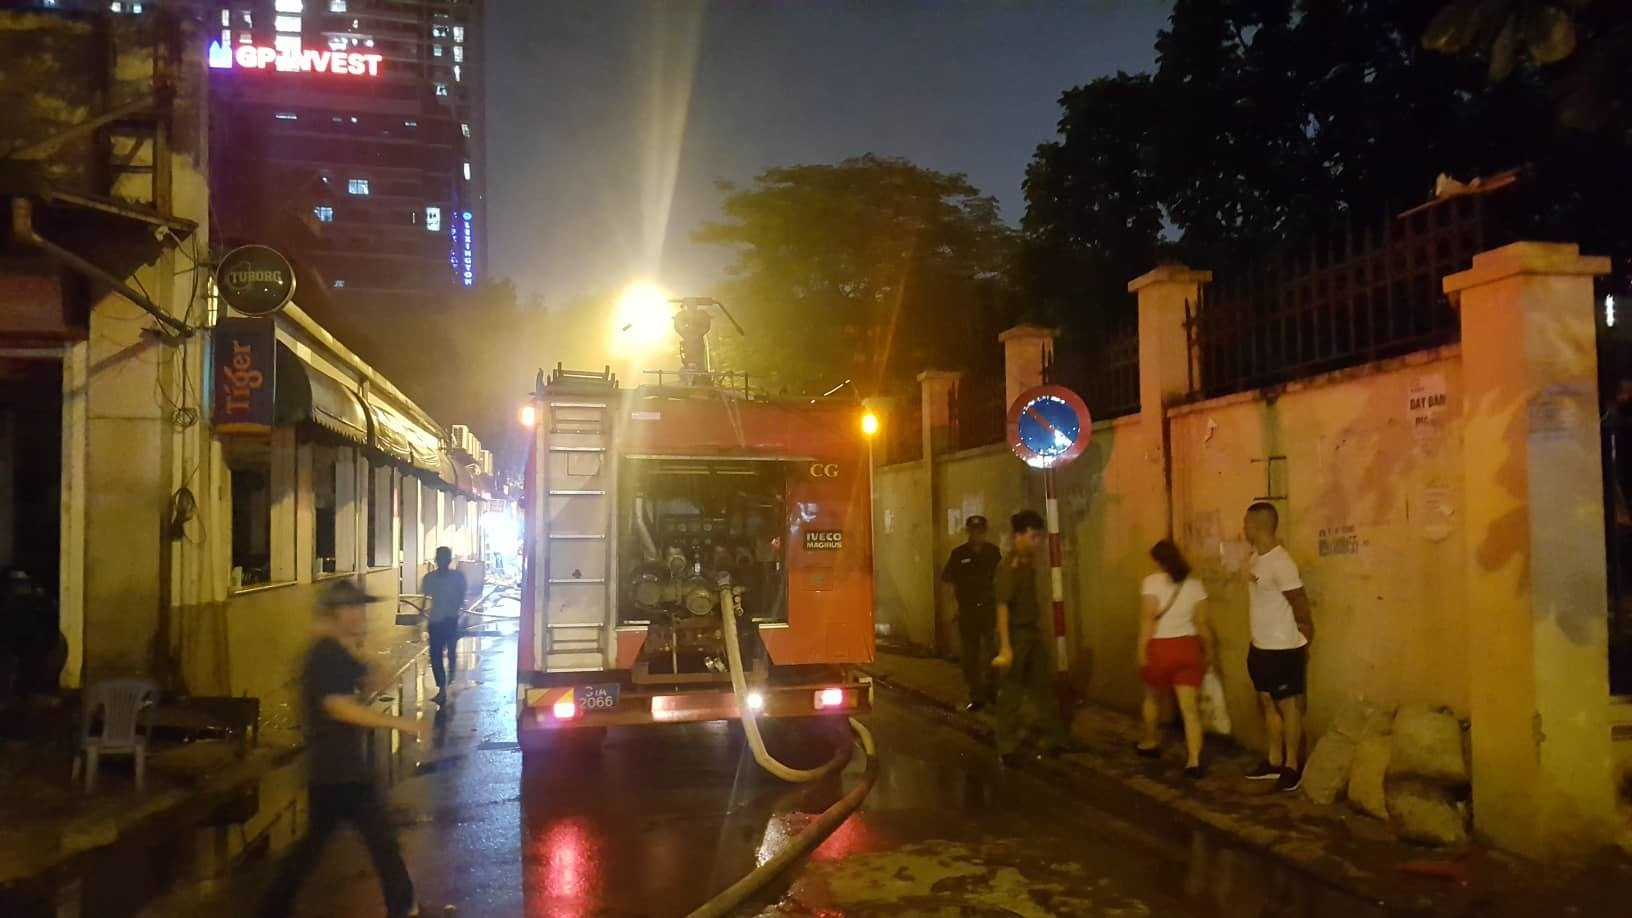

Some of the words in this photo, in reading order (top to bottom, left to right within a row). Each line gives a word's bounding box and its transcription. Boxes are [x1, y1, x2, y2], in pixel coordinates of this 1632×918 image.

[230, 270, 282, 282] TUBORG
[223, 340, 263, 415] Tiger
[810, 463, 839, 477] CG
[806, 532, 842, 541] IVECO
[806, 541, 842, 549] MAGIRUS
